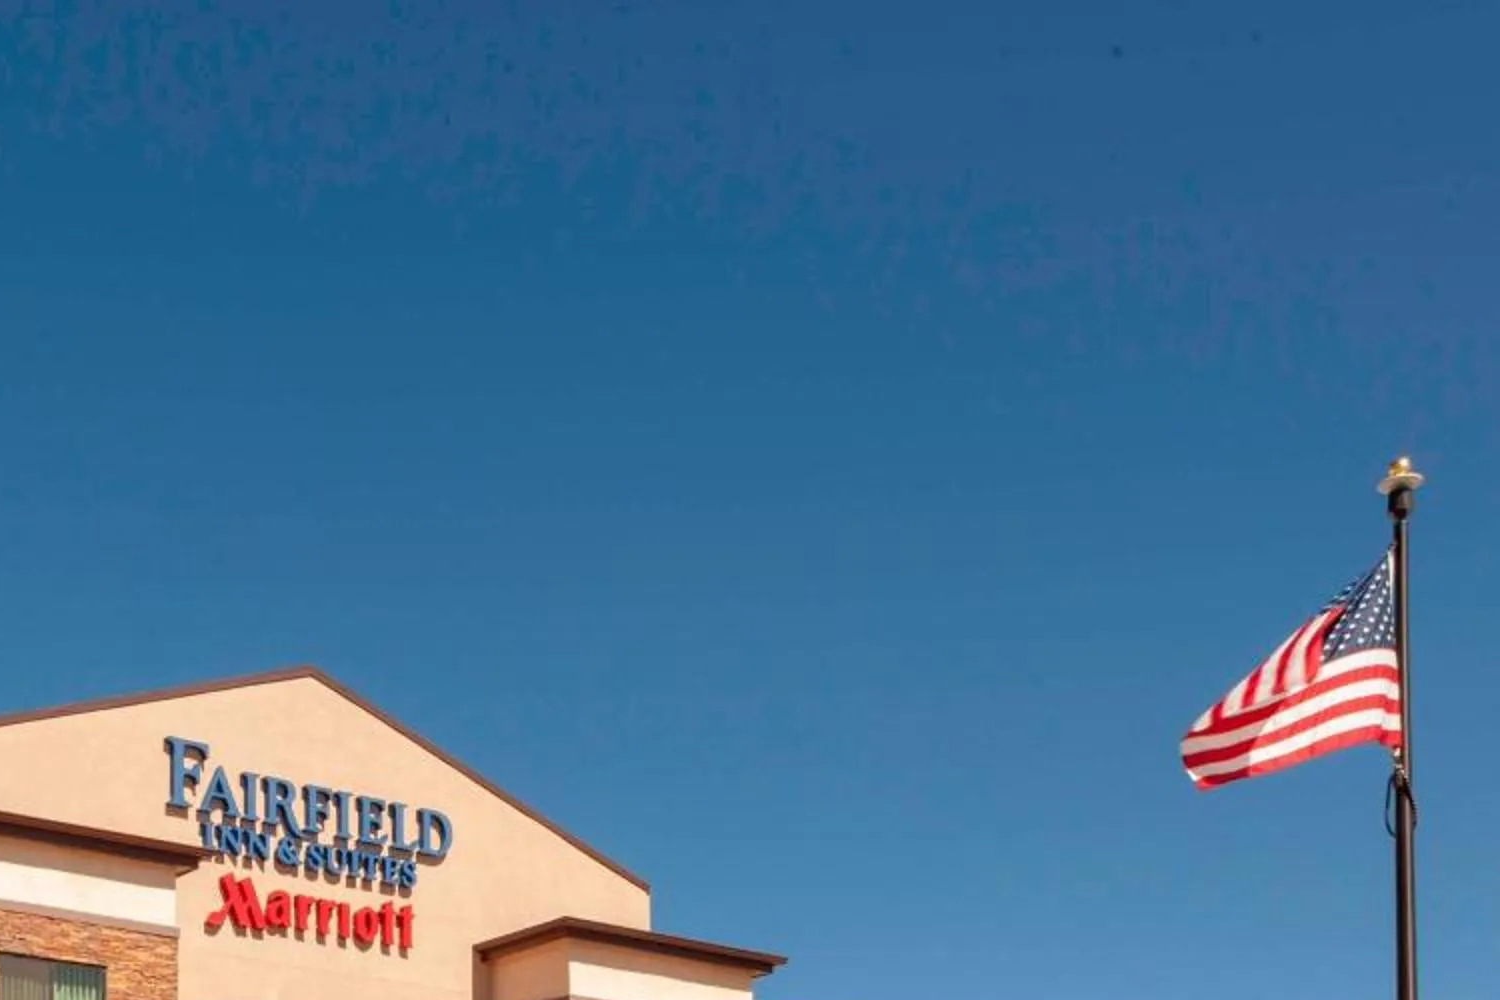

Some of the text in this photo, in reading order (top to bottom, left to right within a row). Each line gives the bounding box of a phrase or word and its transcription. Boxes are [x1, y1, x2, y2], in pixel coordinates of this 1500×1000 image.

[163, 735, 454, 858] FAIRFIELD
[200, 823, 417, 889] INN & SUITES
[203, 871, 415, 949] Marriott
